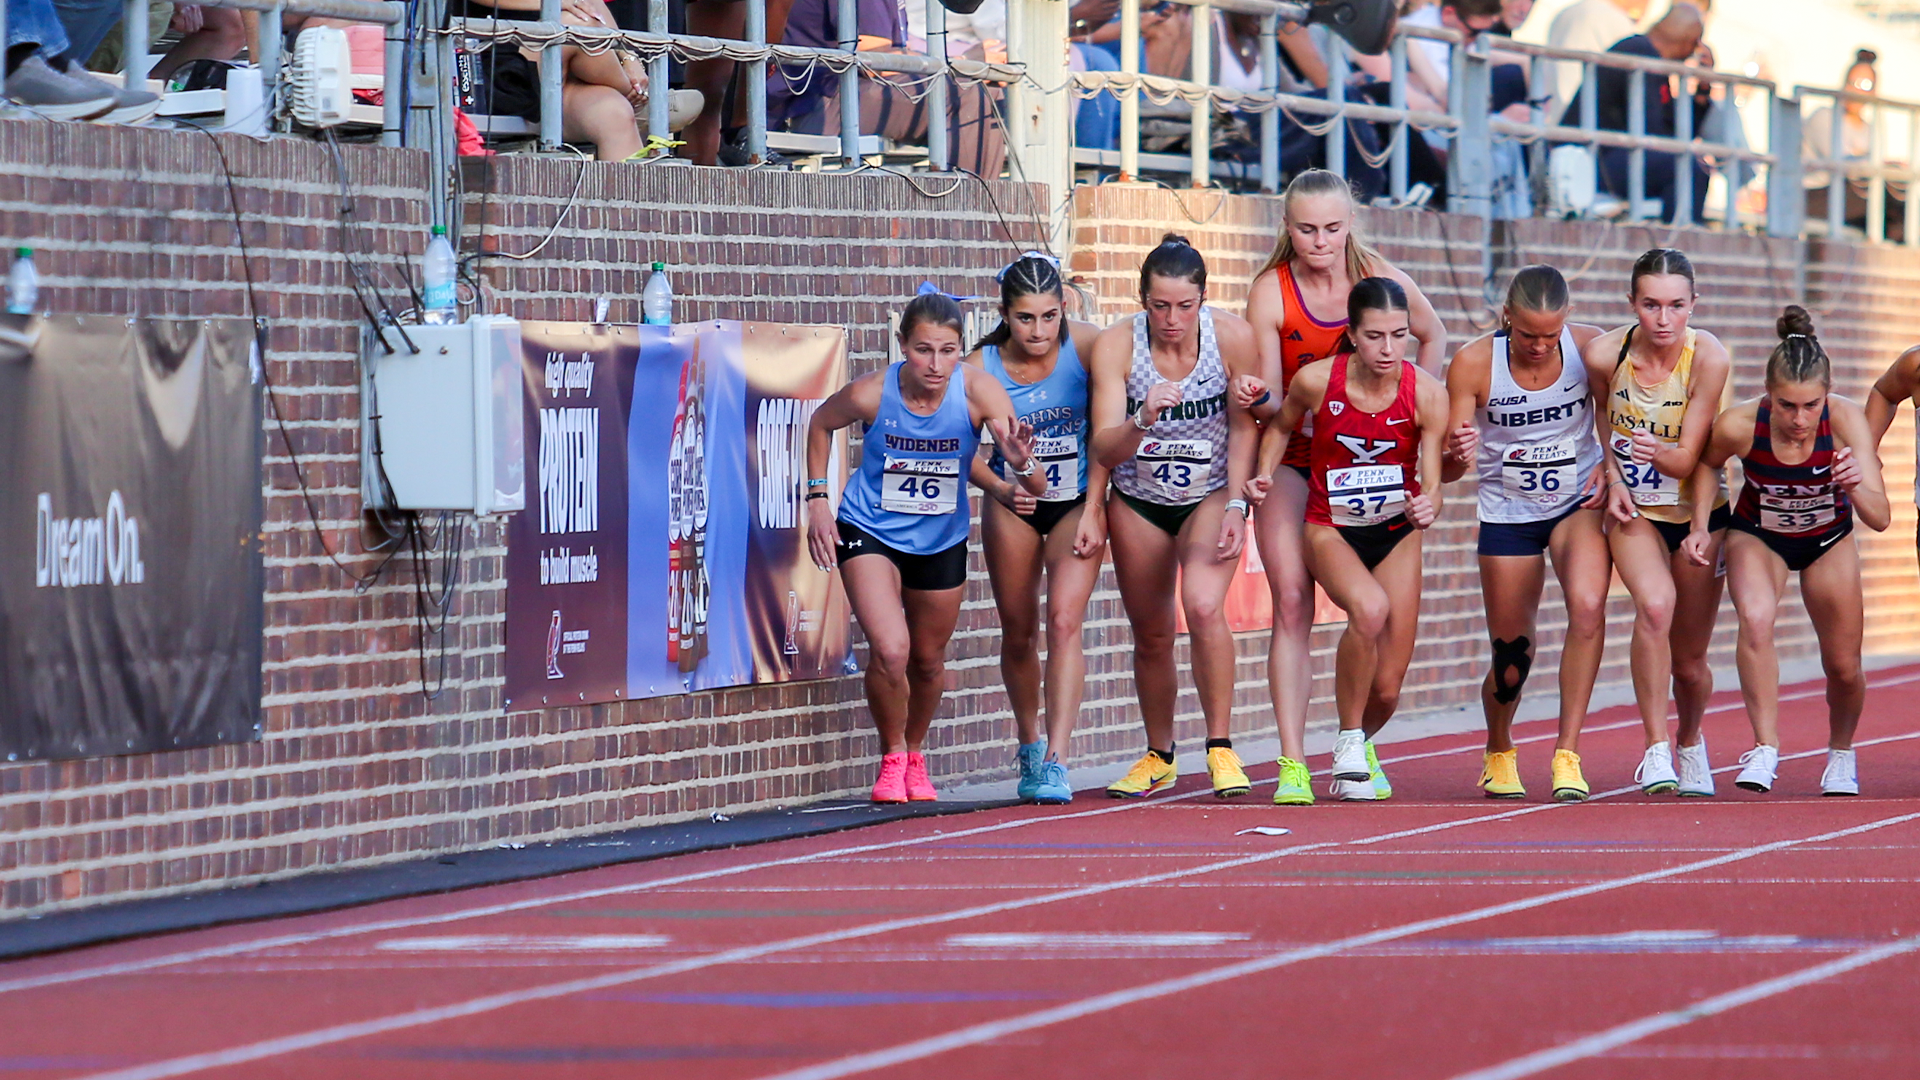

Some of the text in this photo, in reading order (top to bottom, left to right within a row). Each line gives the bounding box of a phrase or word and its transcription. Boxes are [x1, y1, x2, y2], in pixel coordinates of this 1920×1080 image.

[545, 351, 595, 398] high quality
[1018, 406, 1072, 426] OHNS
[1127, 394, 1228, 421] DTMOUTH
[1487, 392, 1589, 427] LIBERTY
[1039, 418, 1082, 438] KINS
[884, 434, 960, 453] WIDENER
[1034, 446, 1070, 454] RELAYS
[1035, 440, 1062, 448] PENN
[1336, 434, 1396, 464] Y
[1533, 445, 1560, 453] PENN
[1532, 450, 1568, 460] RELAYS
[539, 407, 599, 534] PROTEIN
[1046, 464, 1061, 487] 4
[1152, 463, 1191, 488] 43
[1356, 476, 1395, 486] RELAYS
[1357, 469, 1386, 477] PENN
[1519, 469, 1560, 492] 36
[1621, 464, 1663, 490] 34
[898, 477, 940, 499] 46
[1347, 496, 1387, 517] 37
[1777, 513, 1818, 527] 33
[36, 489, 145, 588] Dream On.
[540, 546, 598, 586] to build muscle
